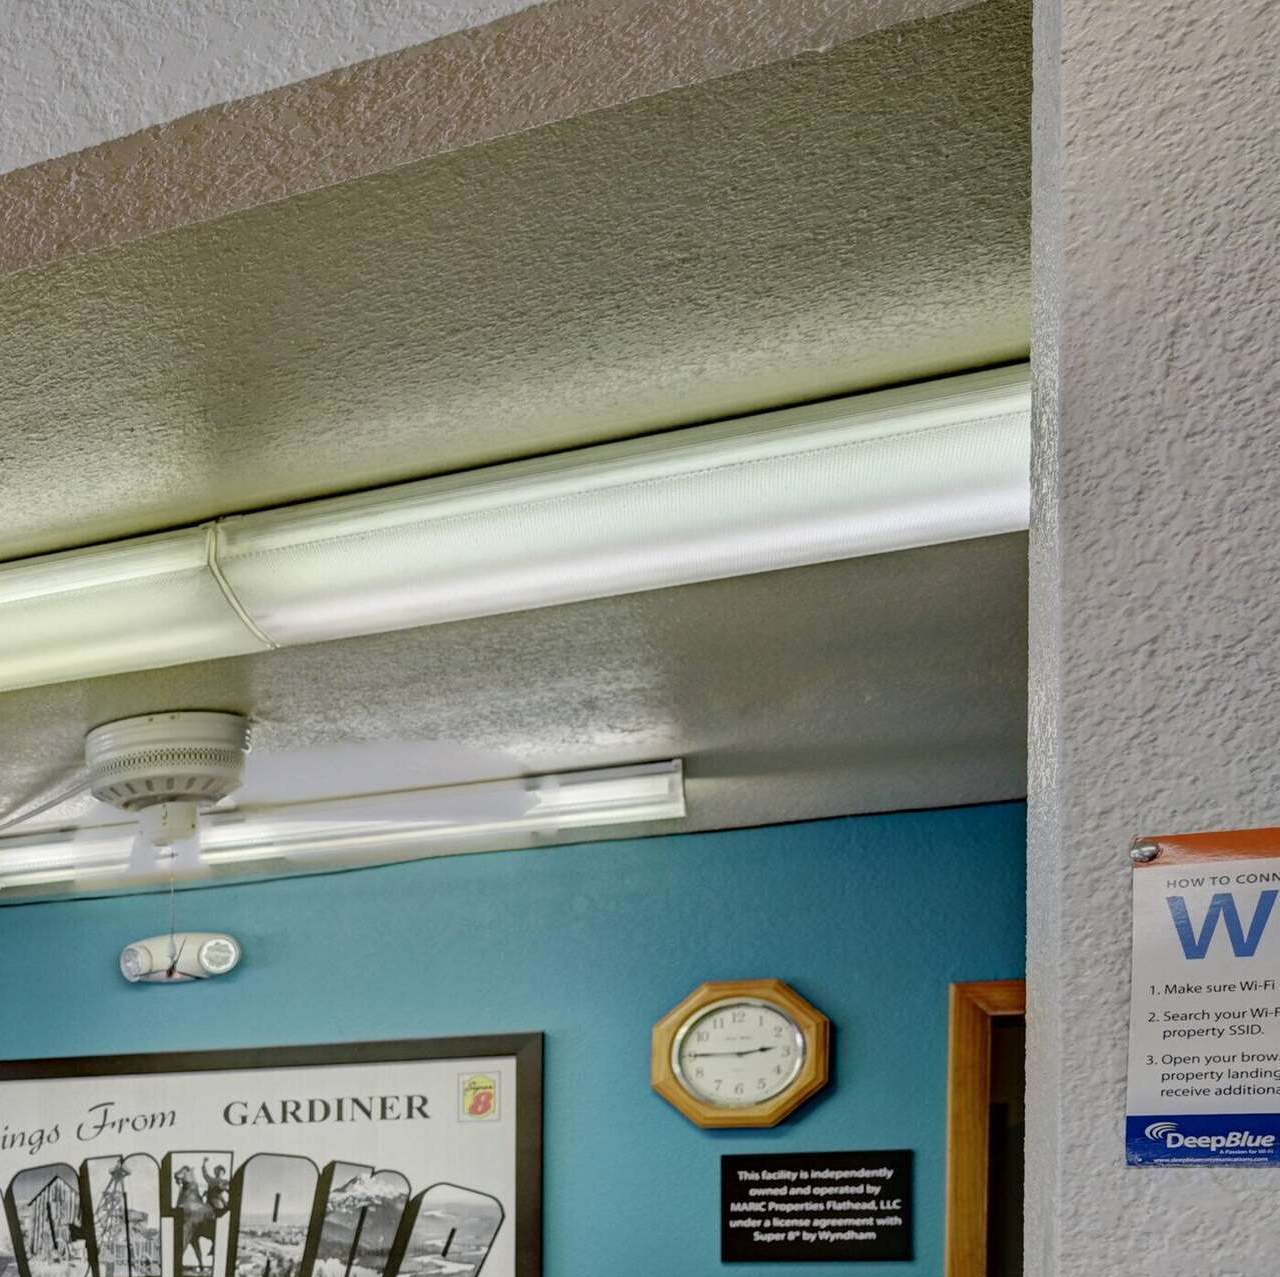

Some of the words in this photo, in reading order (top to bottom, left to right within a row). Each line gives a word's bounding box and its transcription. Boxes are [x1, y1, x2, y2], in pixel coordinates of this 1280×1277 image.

[1166, 877, 1205, 889] HOW
[1209, 875, 1231, 886] TO
[1165, 889, 1279, 960] W
[1149, 985, 1161, 996] 1.
[1164, 983, 1202, 995] Make
[1205, 983, 1237, 994] sure
[1239, 979, 1276, 992] Wi-Fi
[713, 1017, 725, 1029] 11
[732, 1010, 746, 1024] 12
[759, 1015, 764, 1027] 1
[1147, 1011, 1160, 1023] 2.
[1163, 1009, 1211, 1022] Search
[1213, 1009, 1248, 1023] your
[696, 1031, 709, 1043] 10
[773, 1025, 783, 1038] 2
[1162, 1026, 1225, 1041] property
[1228, 1023, 1265, 1036] SSID.
[781, 1045, 791, 1057] 3
[1145, 1054, 1158, 1066] 3.
[1161, 1053, 1201, 1067] Open
[1204, 1053, 1238, 1066] your
[695, 1067, 704, 1078] 8
[773, 1064, 782, 1075] 4
[757, 1078, 766, 1090] 5
[1160, 1070, 1224, 1084] property
[714, 1079, 723, 1091] 7
[734, 1082, 744, 1095] 6
[1160, 1086, 1211, 1097] receive
[468, 1089, 494, 1117] 8
[223, 1094, 431, 1127] GARDINER
[76, 1102, 177, 1142] From
[1166, 1130, 1276, 1152] DeepBlue
[737, 1170, 761, 1181] This
[761, 1169, 798, 1182] facility
[799, 1169, 809, 1180] is
[810, 1167, 894, 1180] independently
[748, 1185, 788, 1196] owned
[788, 1185, 812, 1196] and
[812, 1184, 865, 1197] operated
[865, 1184, 882, 1196] by
[767, 1201, 825, 1213] Properties
[879, 1199, 902, 1210] LLC
[729, 1217, 763, 1228] under
[763, 1219, 771, 1228] a
[772, 1216, 811, 1227] license
[812, 1217, 874, 1228] agreement
[875, 1215, 903, 1227] with
[752, 1230, 786, 1243] Super
[802, 1230, 818, 1243] by
[817, 1229, 877, 1243] Wyndham
